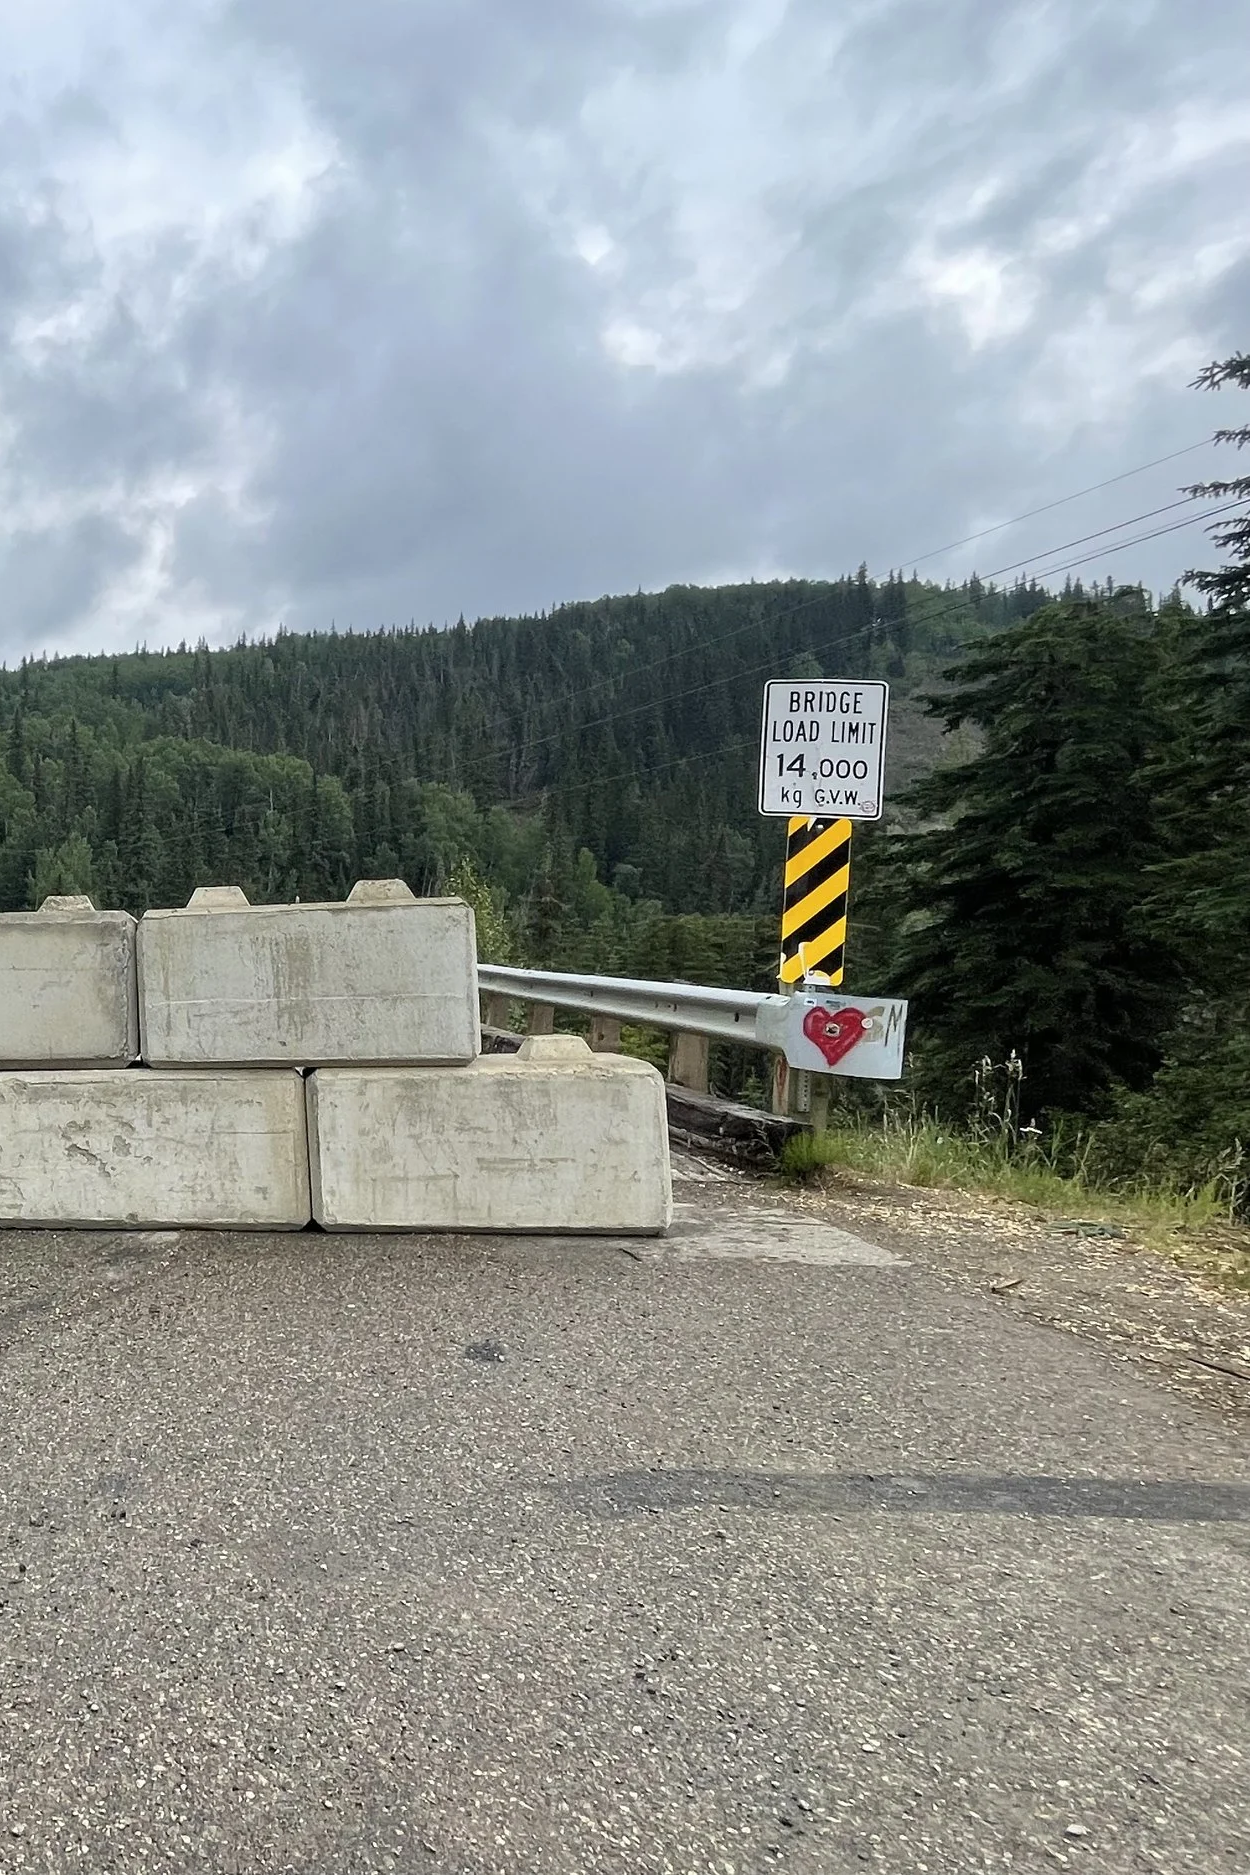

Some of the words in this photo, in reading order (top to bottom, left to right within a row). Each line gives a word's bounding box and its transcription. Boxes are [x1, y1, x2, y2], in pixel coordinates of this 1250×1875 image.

[789, 691, 863, 714] BRIDGE
[772, 720, 820, 742] LOAD
[831, 721, 876, 744] LIMIT
[781, 787, 801, 808] kg
[814, 788, 861, 806] G.V.W.
